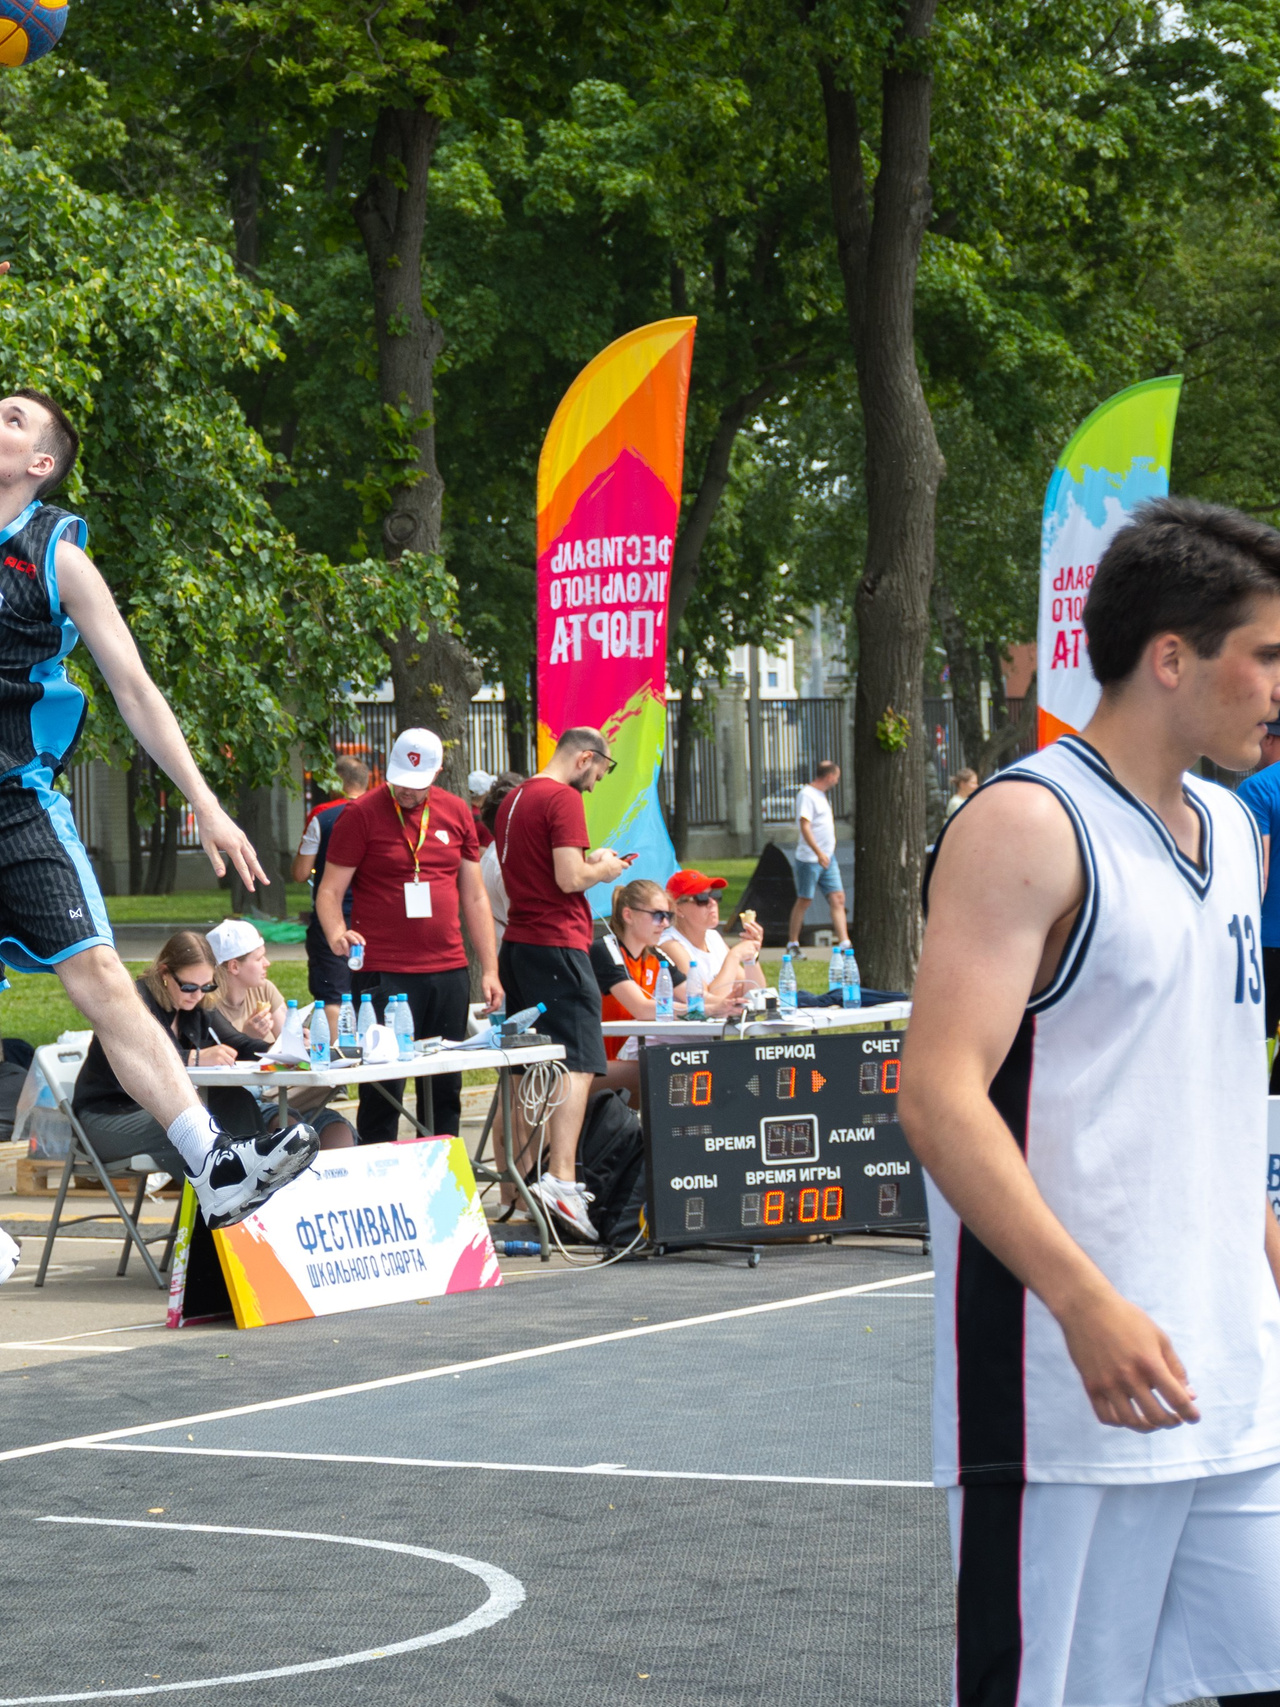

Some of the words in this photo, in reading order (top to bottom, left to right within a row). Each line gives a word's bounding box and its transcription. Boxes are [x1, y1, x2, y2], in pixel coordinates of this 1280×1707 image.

[1227, 913, 1262, 1004] 13
[755, 1044, 816, 1061] ПЕРИОД
[862, 1039, 900, 1054] СЧЕТ
[670, 1050, 710, 1066] СЧЕТ
[691, 1071, 713, 1106] 0
[704, 1135, 757, 1152] ВРЕМЯ
[828, 1127, 876, 1144] АТАКИ
[745, 1168, 797, 1186] ВРЕМЯ
[799, 1166, 841, 1182] ИГРЫ
[863, 1161, 911, 1178] ФОЛЫ
[670, 1174, 718, 1191] ФОЛЫ
[296, 1202, 417, 1255] ФЕСТИВАЛЬ
[306, 1255, 380, 1289] ШКОЛЬНОГО
[380, 1248, 428, 1276] СПОРТА
